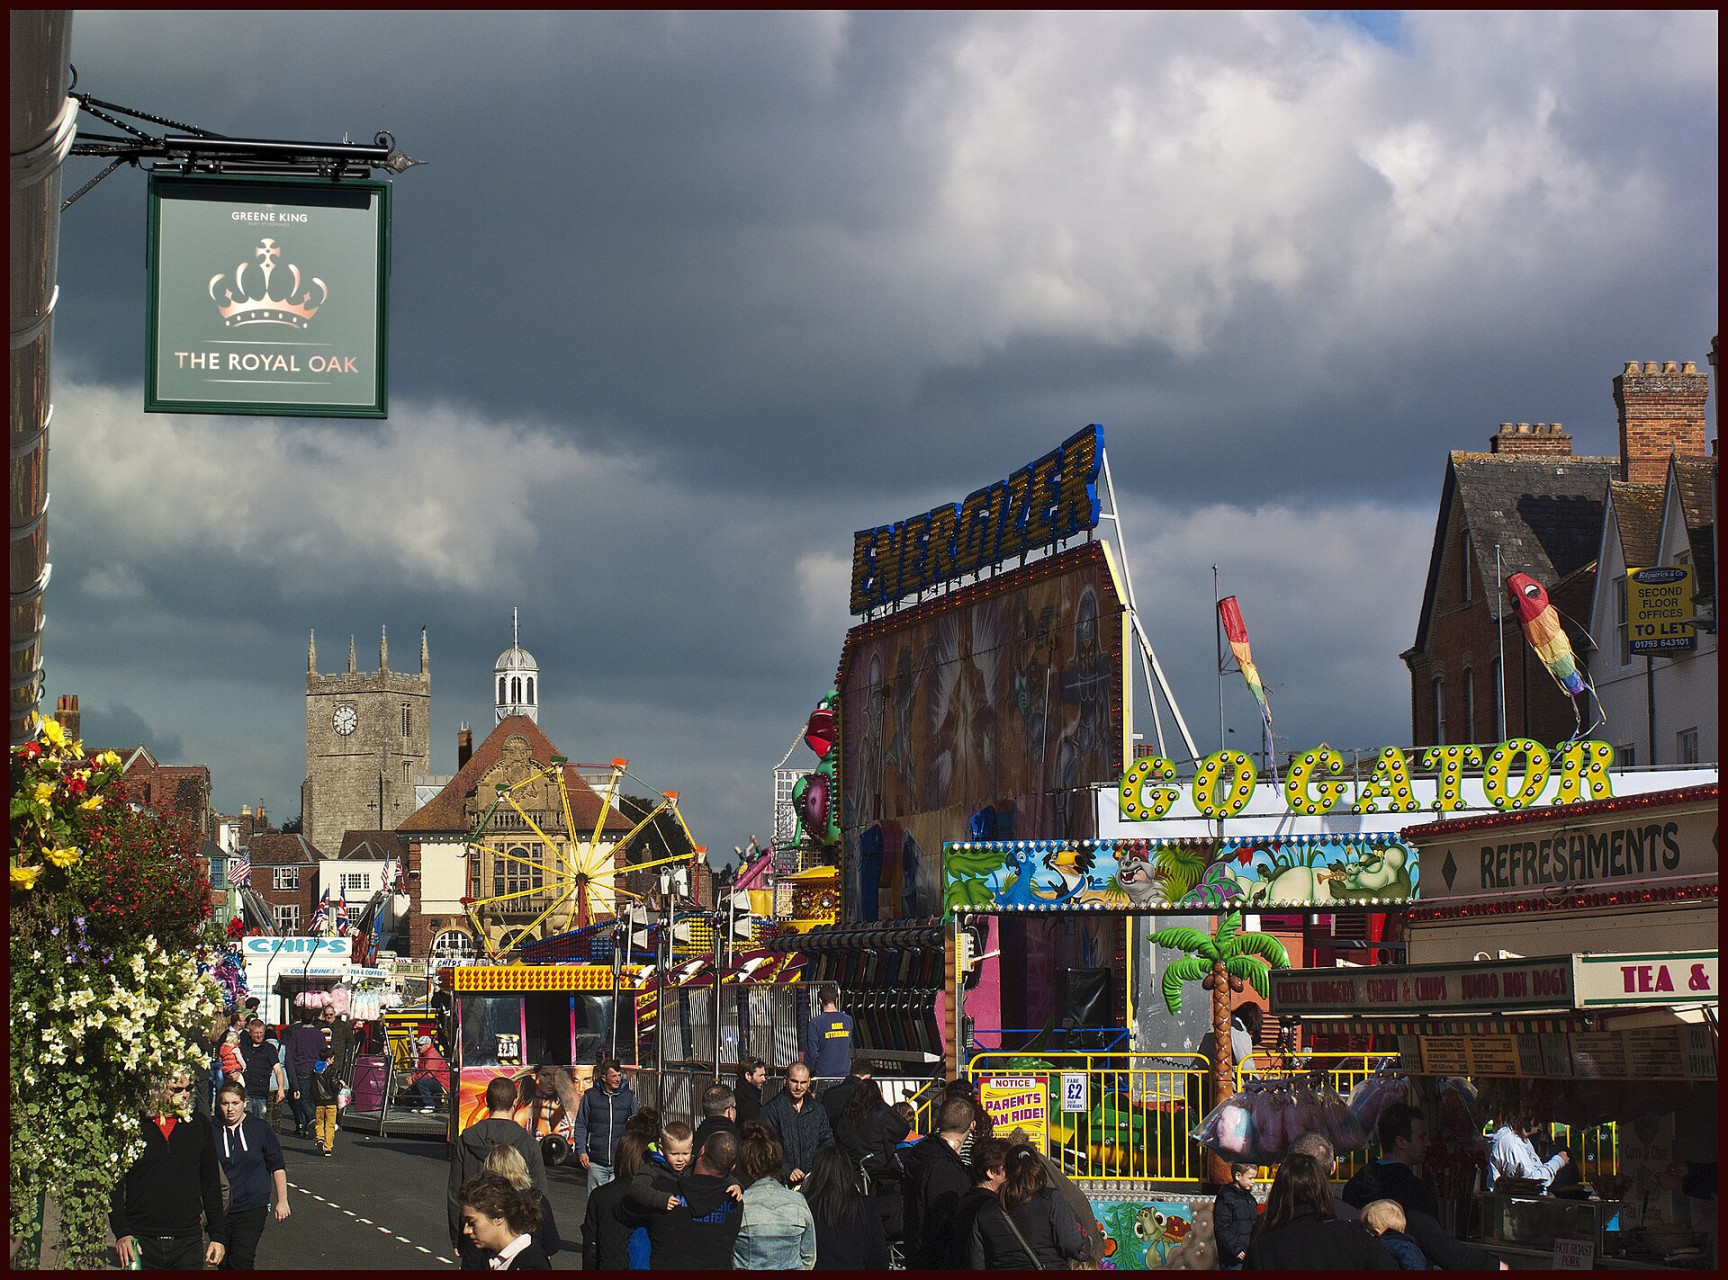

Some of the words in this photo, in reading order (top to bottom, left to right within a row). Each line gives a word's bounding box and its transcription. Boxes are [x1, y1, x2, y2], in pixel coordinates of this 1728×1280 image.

[231, 211, 276, 222] GREENE
[279, 212, 308, 223] KING
[174, 352, 220, 370] THE
[228, 353, 301, 372] ROYAL
[308, 355, 359, 373] OAK
[850, 423, 1105, 616] ENERGIZER
[1638, 571, 1669, 579] Kilpatrick
[1638, 586, 1683, 598] SECOND
[1642, 598, 1679, 609] FLOOR
[1638, 608, 1684, 620] OFFICES
[1634, 623, 1656, 637] TO
[1660, 622, 1687, 635] LET
[1635, 640, 1657, 648] 01793
[1660, 638, 1690, 647] 643101
[1118, 748, 1259, 822] GO
[1285, 737, 1617, 819] GATOR
[1480, 821, 1681, 889] REFRESHMENTS
[247, 938, 347, 954] CHIPS
[437, 959, 462, 968] CHIPS
[1275, 981, 1309, 1002] CHEESE
[1311, 979, 1355, 1003] BURGERS
[1366, 978, 1399, 1003] CURRY
[1414, 975, 1448, 1001] CHIPS
[1460, 972, 1499, 1000] JUMBO
[1502, 970, 1528, 999] HOT
[1532, 967, 1568, 997] DOGS
[1620, 964, 1675, 993] TEA
[1688, 963, 1711, 991] &
[497, 1042, 519, 1057] £2.50
[995, 1079, 1030, 1087] NOTICE
[1067, 1083, 1083, 1100] £2
[985, 1092, 1041, 1112] PARENTS
[993, 1112, 1009, 1126] AN
[1011, 1107, 1045, 1123] RIDE!
[1555, 1242, 1570, 1254] HOT
[1561, 1255, 1581, 1268] PORK
